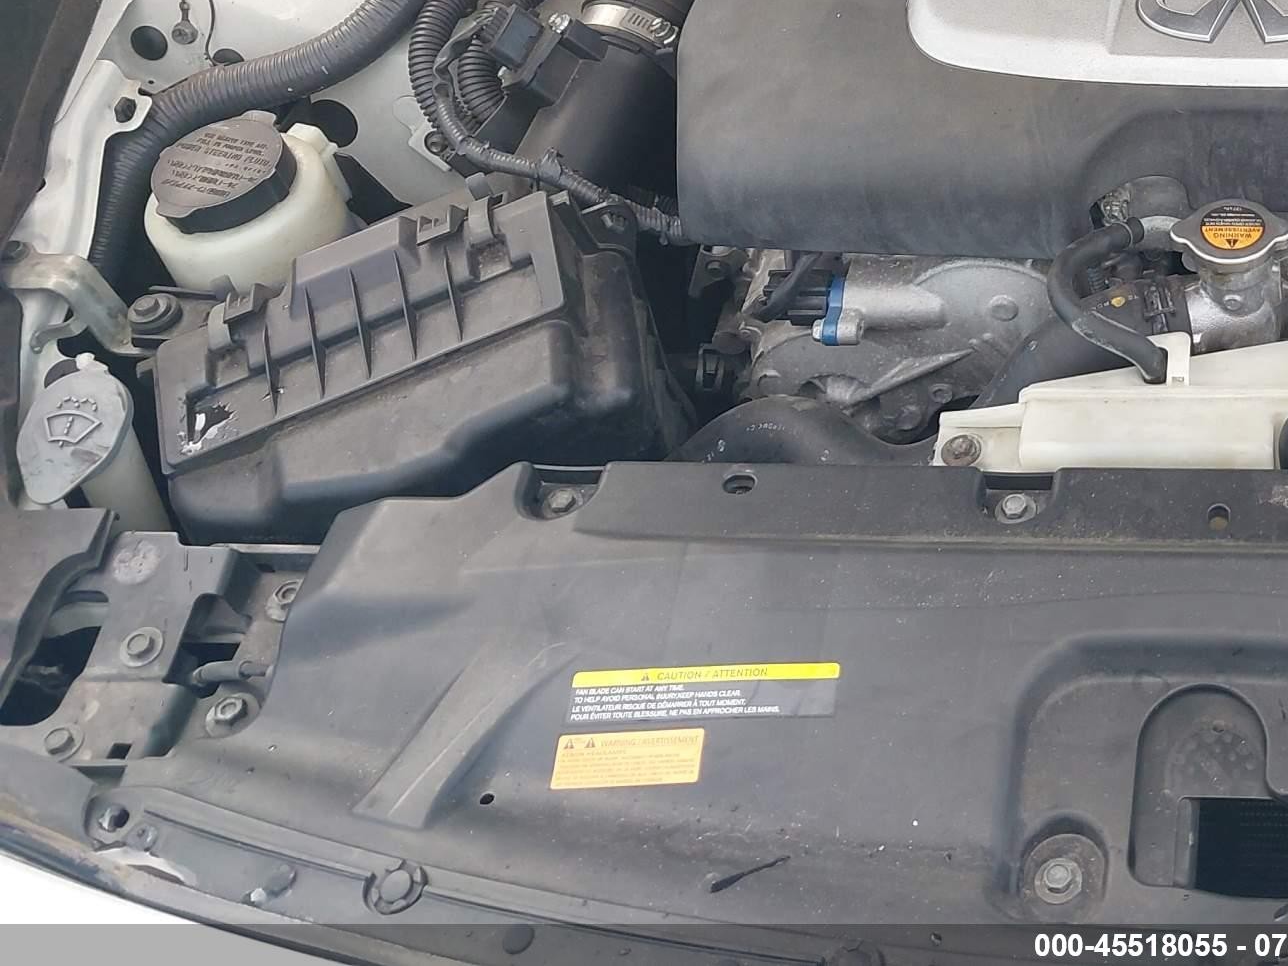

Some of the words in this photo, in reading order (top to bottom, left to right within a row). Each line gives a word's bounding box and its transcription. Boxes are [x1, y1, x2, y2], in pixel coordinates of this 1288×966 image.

[204, 147, 242, 161] STEERING
[657, 671, 701, 680] CAUTION
[713, 667, 768, 678] ATTENTION
[588, 687, 609, 695] BLADE
[610, 686, 625, 694] CAN
[625, 685, 646, 693] START
[654, 684, 668, 692] ANY
[584, 695, 601, 703] HELP
[601, 694, 620, 703] AVOID
[621, 693, 655, 701] PERSONAL
[694, 690, 718, 698] HANDS
[580, 703, 621, 712] VENTILATEUR
[622, 702, 646, 710] RISQUE
[699, 699, 715, 707] TOUT
[571, 713, 589, 721] POUR
[590, 712, 612, 720] ÉVITER
[612, 711, 633, 719] TOUTE
[679, 708, 691, 716] PAS
[702, 706, 744, 715] APPROCHER
[600, 738, 636, 747] WARNING
[641, 735, 699, 745] AVERTISSEMENT
